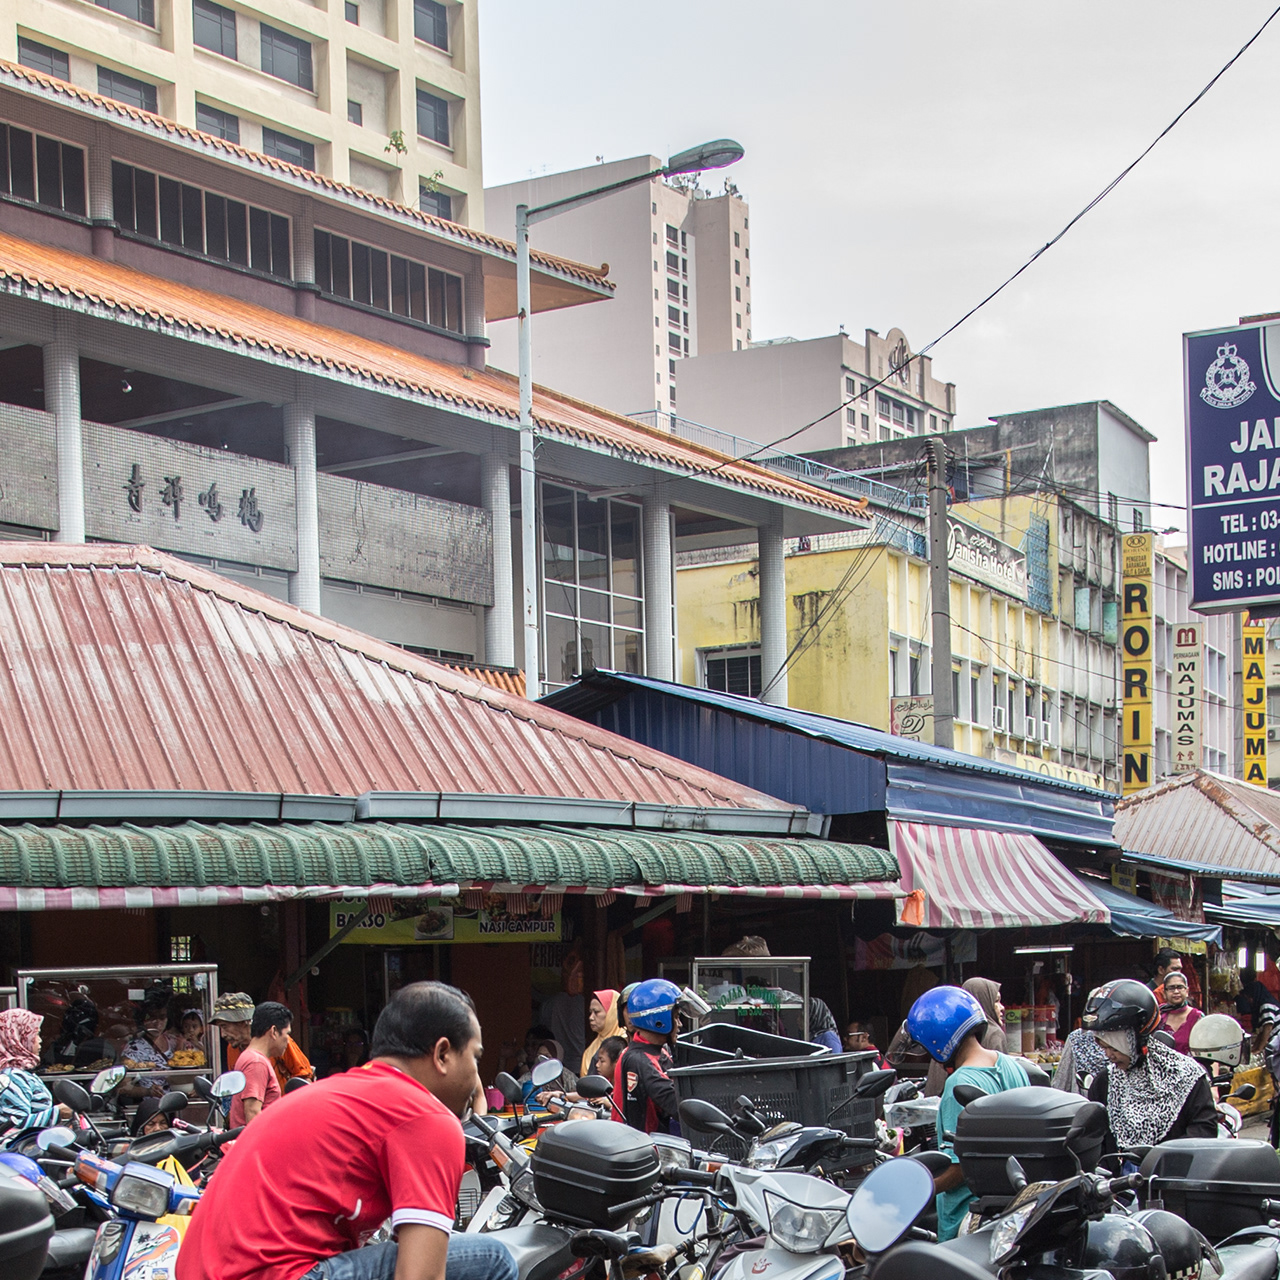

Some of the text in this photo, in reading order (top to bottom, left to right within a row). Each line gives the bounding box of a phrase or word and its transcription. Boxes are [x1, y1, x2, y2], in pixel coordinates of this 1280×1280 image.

[1220, 513, 1248, 534] TEL
[1203, 539, 1267, 564] HOTLINE
[990, 555, 1016, 582] Hotel
[1213, 569, 1243, 591] SMS
[1177, 661, 1196, 746] MAJUMAS
[479, 921, 506, 934] NASI
[508, 919, 556, 934] CAMPUR
